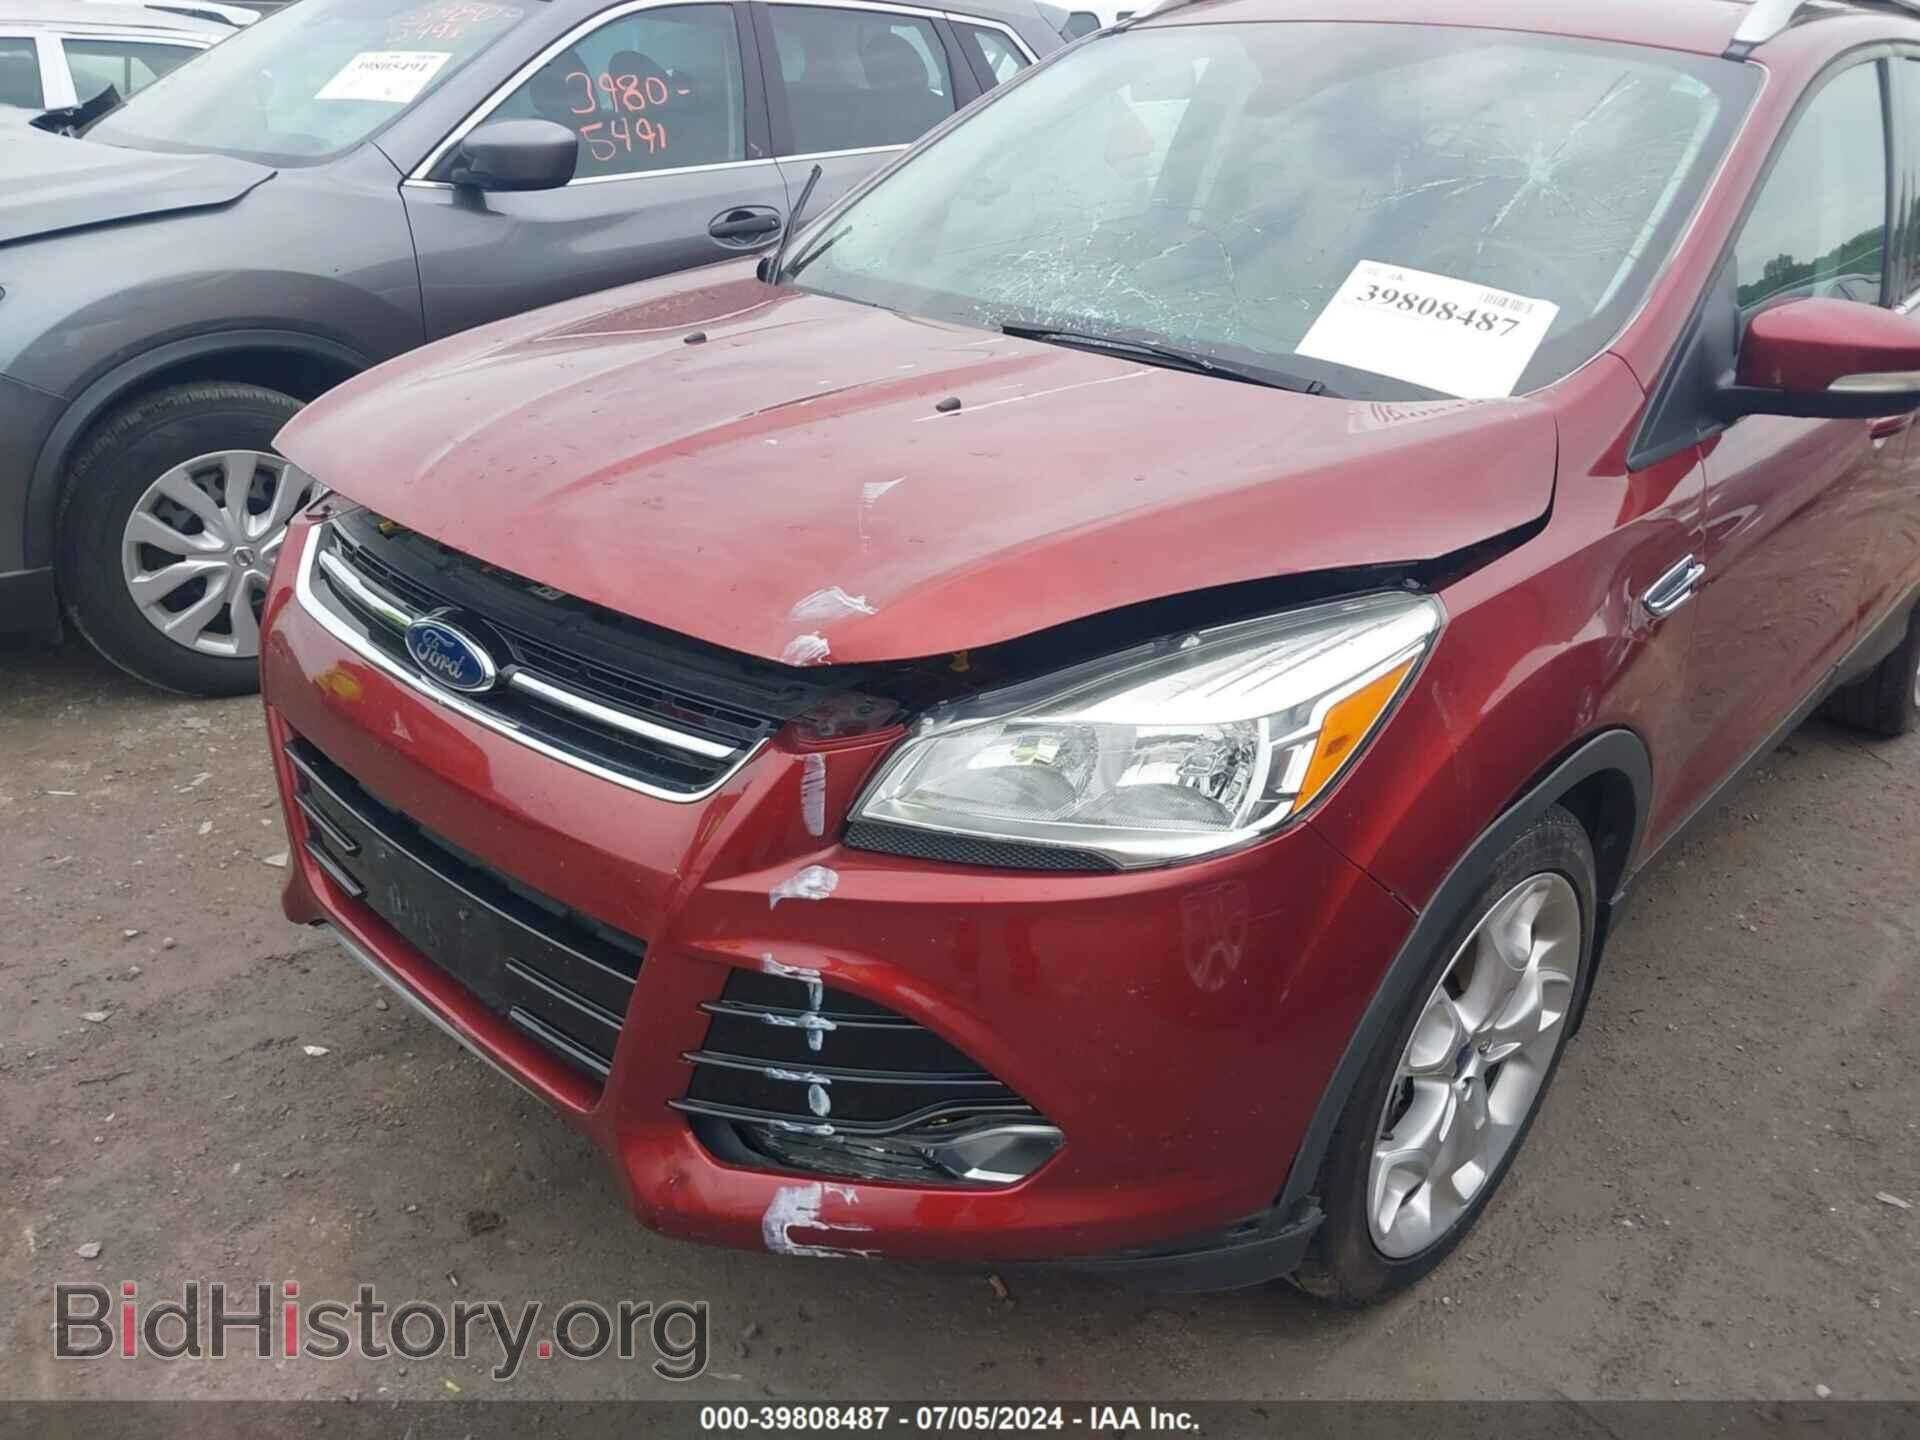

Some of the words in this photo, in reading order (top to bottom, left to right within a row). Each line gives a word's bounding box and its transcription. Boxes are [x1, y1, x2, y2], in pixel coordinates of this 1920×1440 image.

[580, 117, 667, 161] 5491
[1357, 285, 1520, 336] 39808487
[416, 629, 463, 679] Ford
